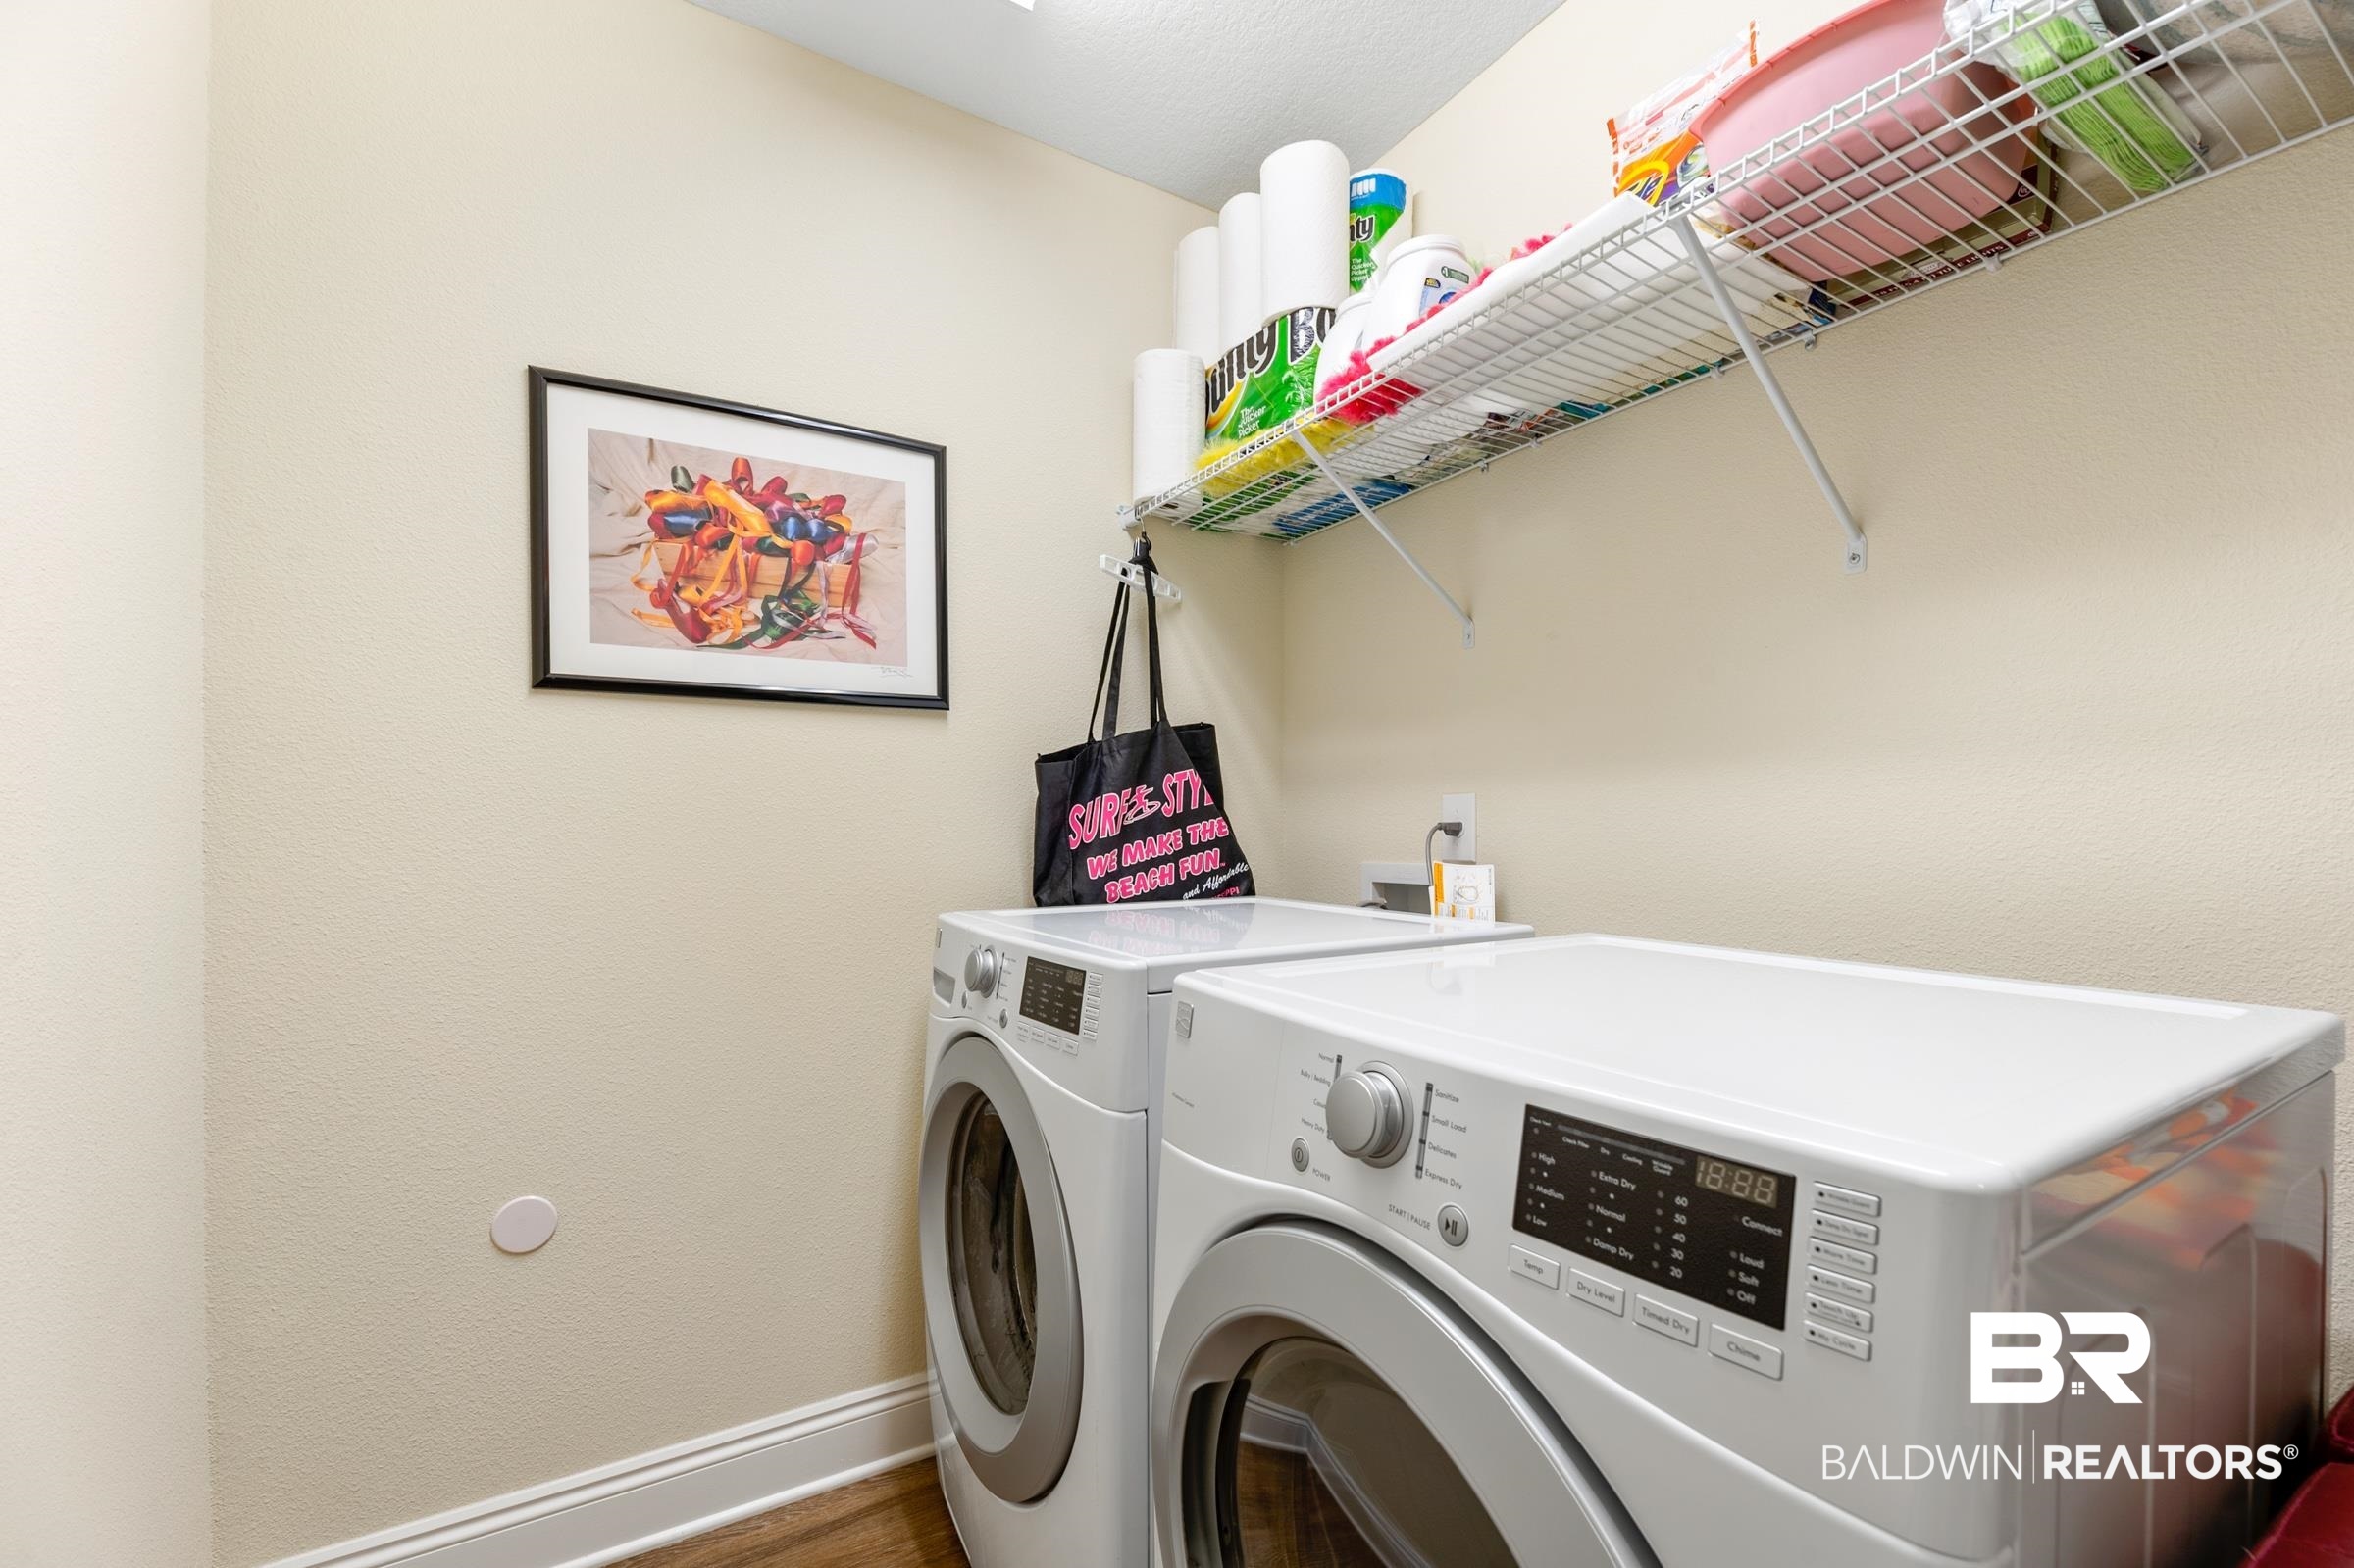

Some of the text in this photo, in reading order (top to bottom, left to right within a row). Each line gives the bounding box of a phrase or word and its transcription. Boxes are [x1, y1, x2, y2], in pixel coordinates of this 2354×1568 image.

[1068, 788, 1131, 850] SURF
[1087, 816, 1230, 880] WE MAKE THE
[1104, 863, 1175, 904] BEACH
[1182, 884, 1201, 900] and
[1202, 862, 1250, 892] Affordable
[1431, 1115, 1467, 1134] Small Load
[1428, 1141, 1457, 1159] Delicates
[1538, 1152, 1556, 1166] High
[1424, 1168, 1463, 1190] Express Dry
[1598, 1171, 1637, 1191] Extra Dry
[1535, 1184, 1565, 1201] Medium
[1674, 1195, 1689, 1208] 60
[1388, 1203, 1431, 1231] START PAUSE
[1532, 1214, 1547, 1226] Low
[1595, 1204, 1626, 1223] Normal
[1673, 1212, 1688, 1225] 50
[1741, 1215, 1783, 1238] Connect
[1671, 1232, 1686, 1243] 40
[1593, 1238, 1635, 1261] Damp Dry
[1670, 1248, 1685, 1261] 30
[1523, 1258, 1545, 1276] Temp
[1739, 1252, 1765, 1269] Loud
[1669, 1266, 1684, 1279] 20
[1737, 1271, 1760, 1287] Soft
[1576, 1280, 1616, 1303] Dry Level
[1736, 1289, 1757, 1305] Off
[1641, 1305, 1691, 1335] Timed Dry
[1726, 1340, 1762, 1362] Chime
